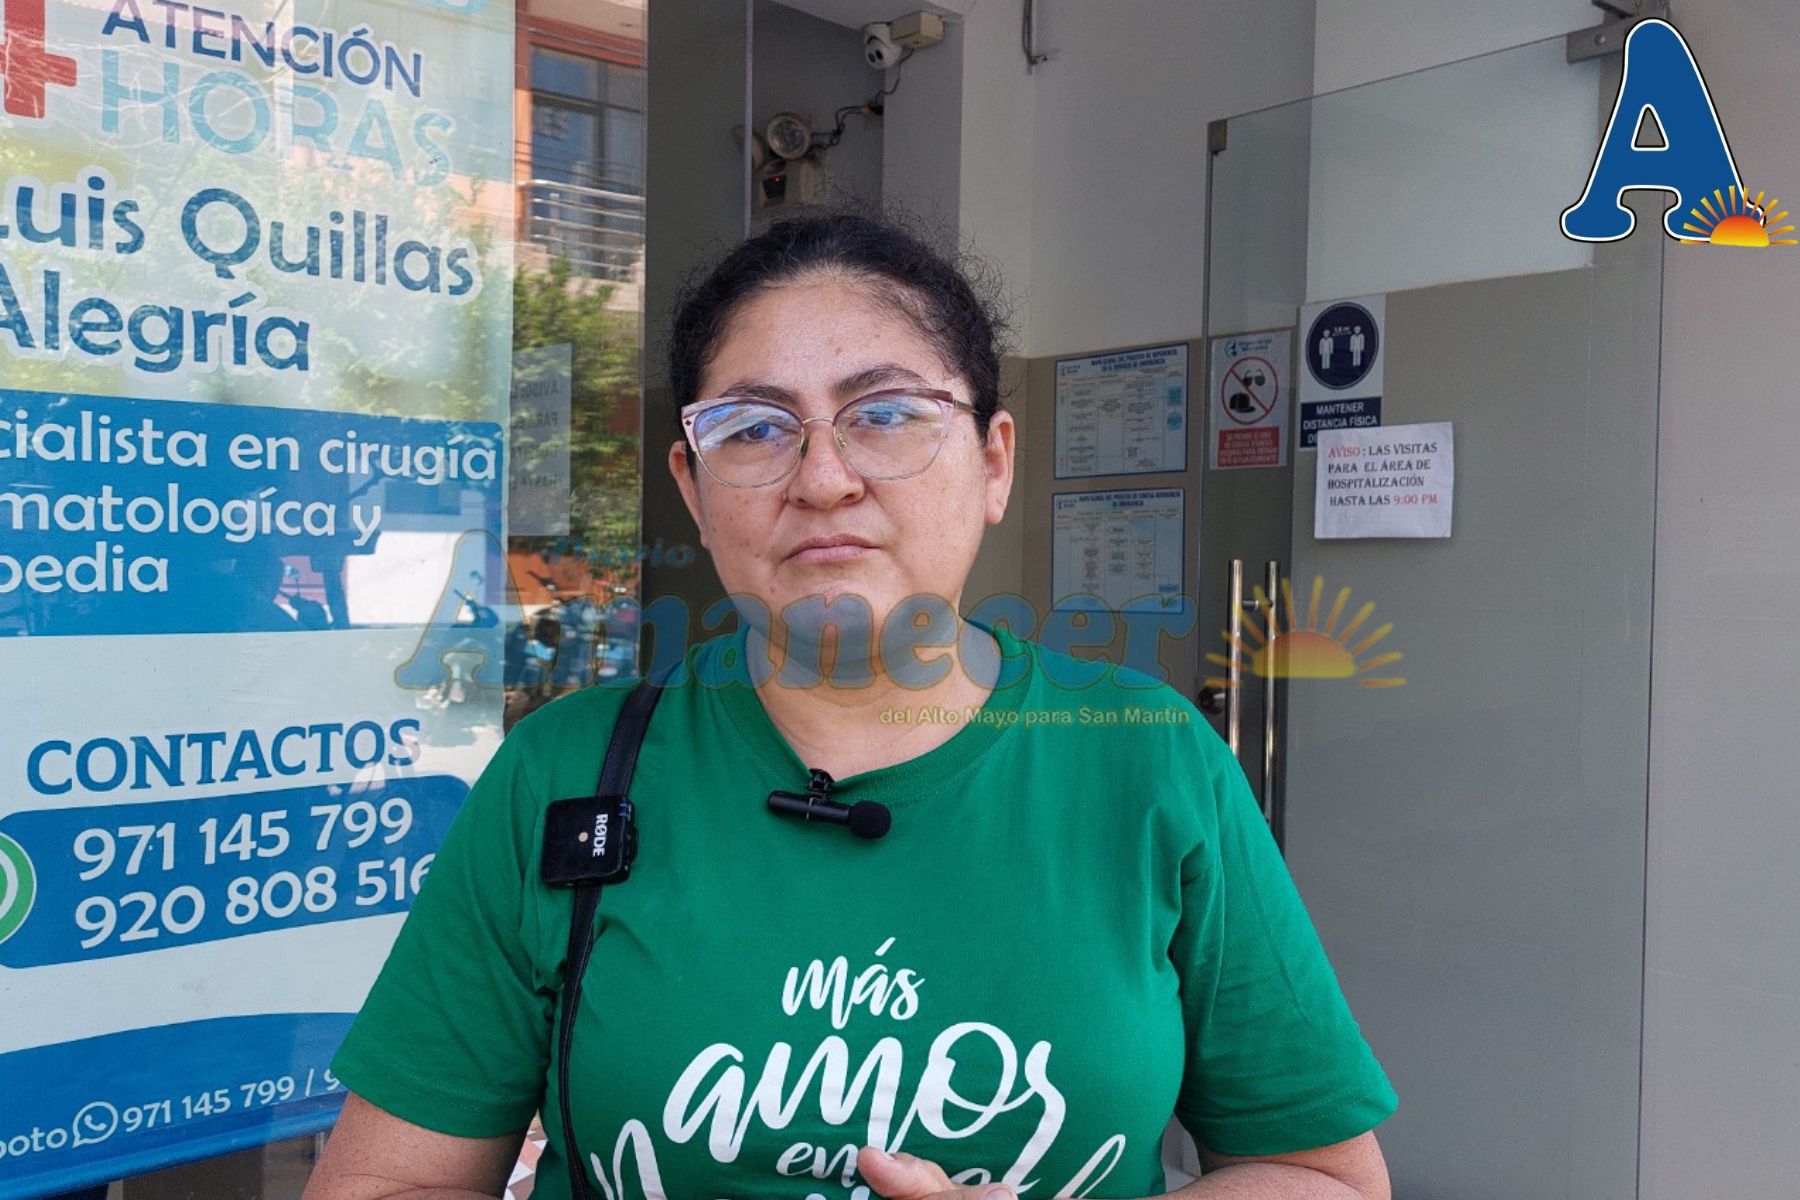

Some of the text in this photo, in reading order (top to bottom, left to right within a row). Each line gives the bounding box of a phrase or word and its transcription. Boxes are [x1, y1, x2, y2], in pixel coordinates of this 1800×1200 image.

[101, 0, 422, 98] ATENCIÓN
[100, 51, 455, 187] HORAS
[0, 176, 475, 296] uis Quillas
[1303, 418, 1347, 430] DISTANCIA
[1316, 402, 1364, 415] MANTENER
[229, 433, 299, 470] en
[319, 431, 497, 485] cirugía
[1328, 458, 1431, 474] PARA EL ÁREA DE
[1368, 445, 1391, 456] LAS
[1393, 442, 1438, 454] VISITAS
[1328, 473, 1424, 490] HOSPITALIZACIÓN
[1329, 493, 1438, 506] HASTA LAS 9:00 PM
[352, 505, 381, 546] y
[27, 718, 421, 795] CONTACTOS
[73, 797, 413, 882] 971 145 799
[75, 886, 205, 949] 920
[225, 866, 337, 925] 808
[781, 936, 926, 1029] más
[123, 1100, 172, 1132] 971
[182, 1089, 231, 1119] 145
[240, 1076, 295, 1108] 799
[662, 1021, 1067, 1193] amor
[775, 1141, 868, 1187] en
